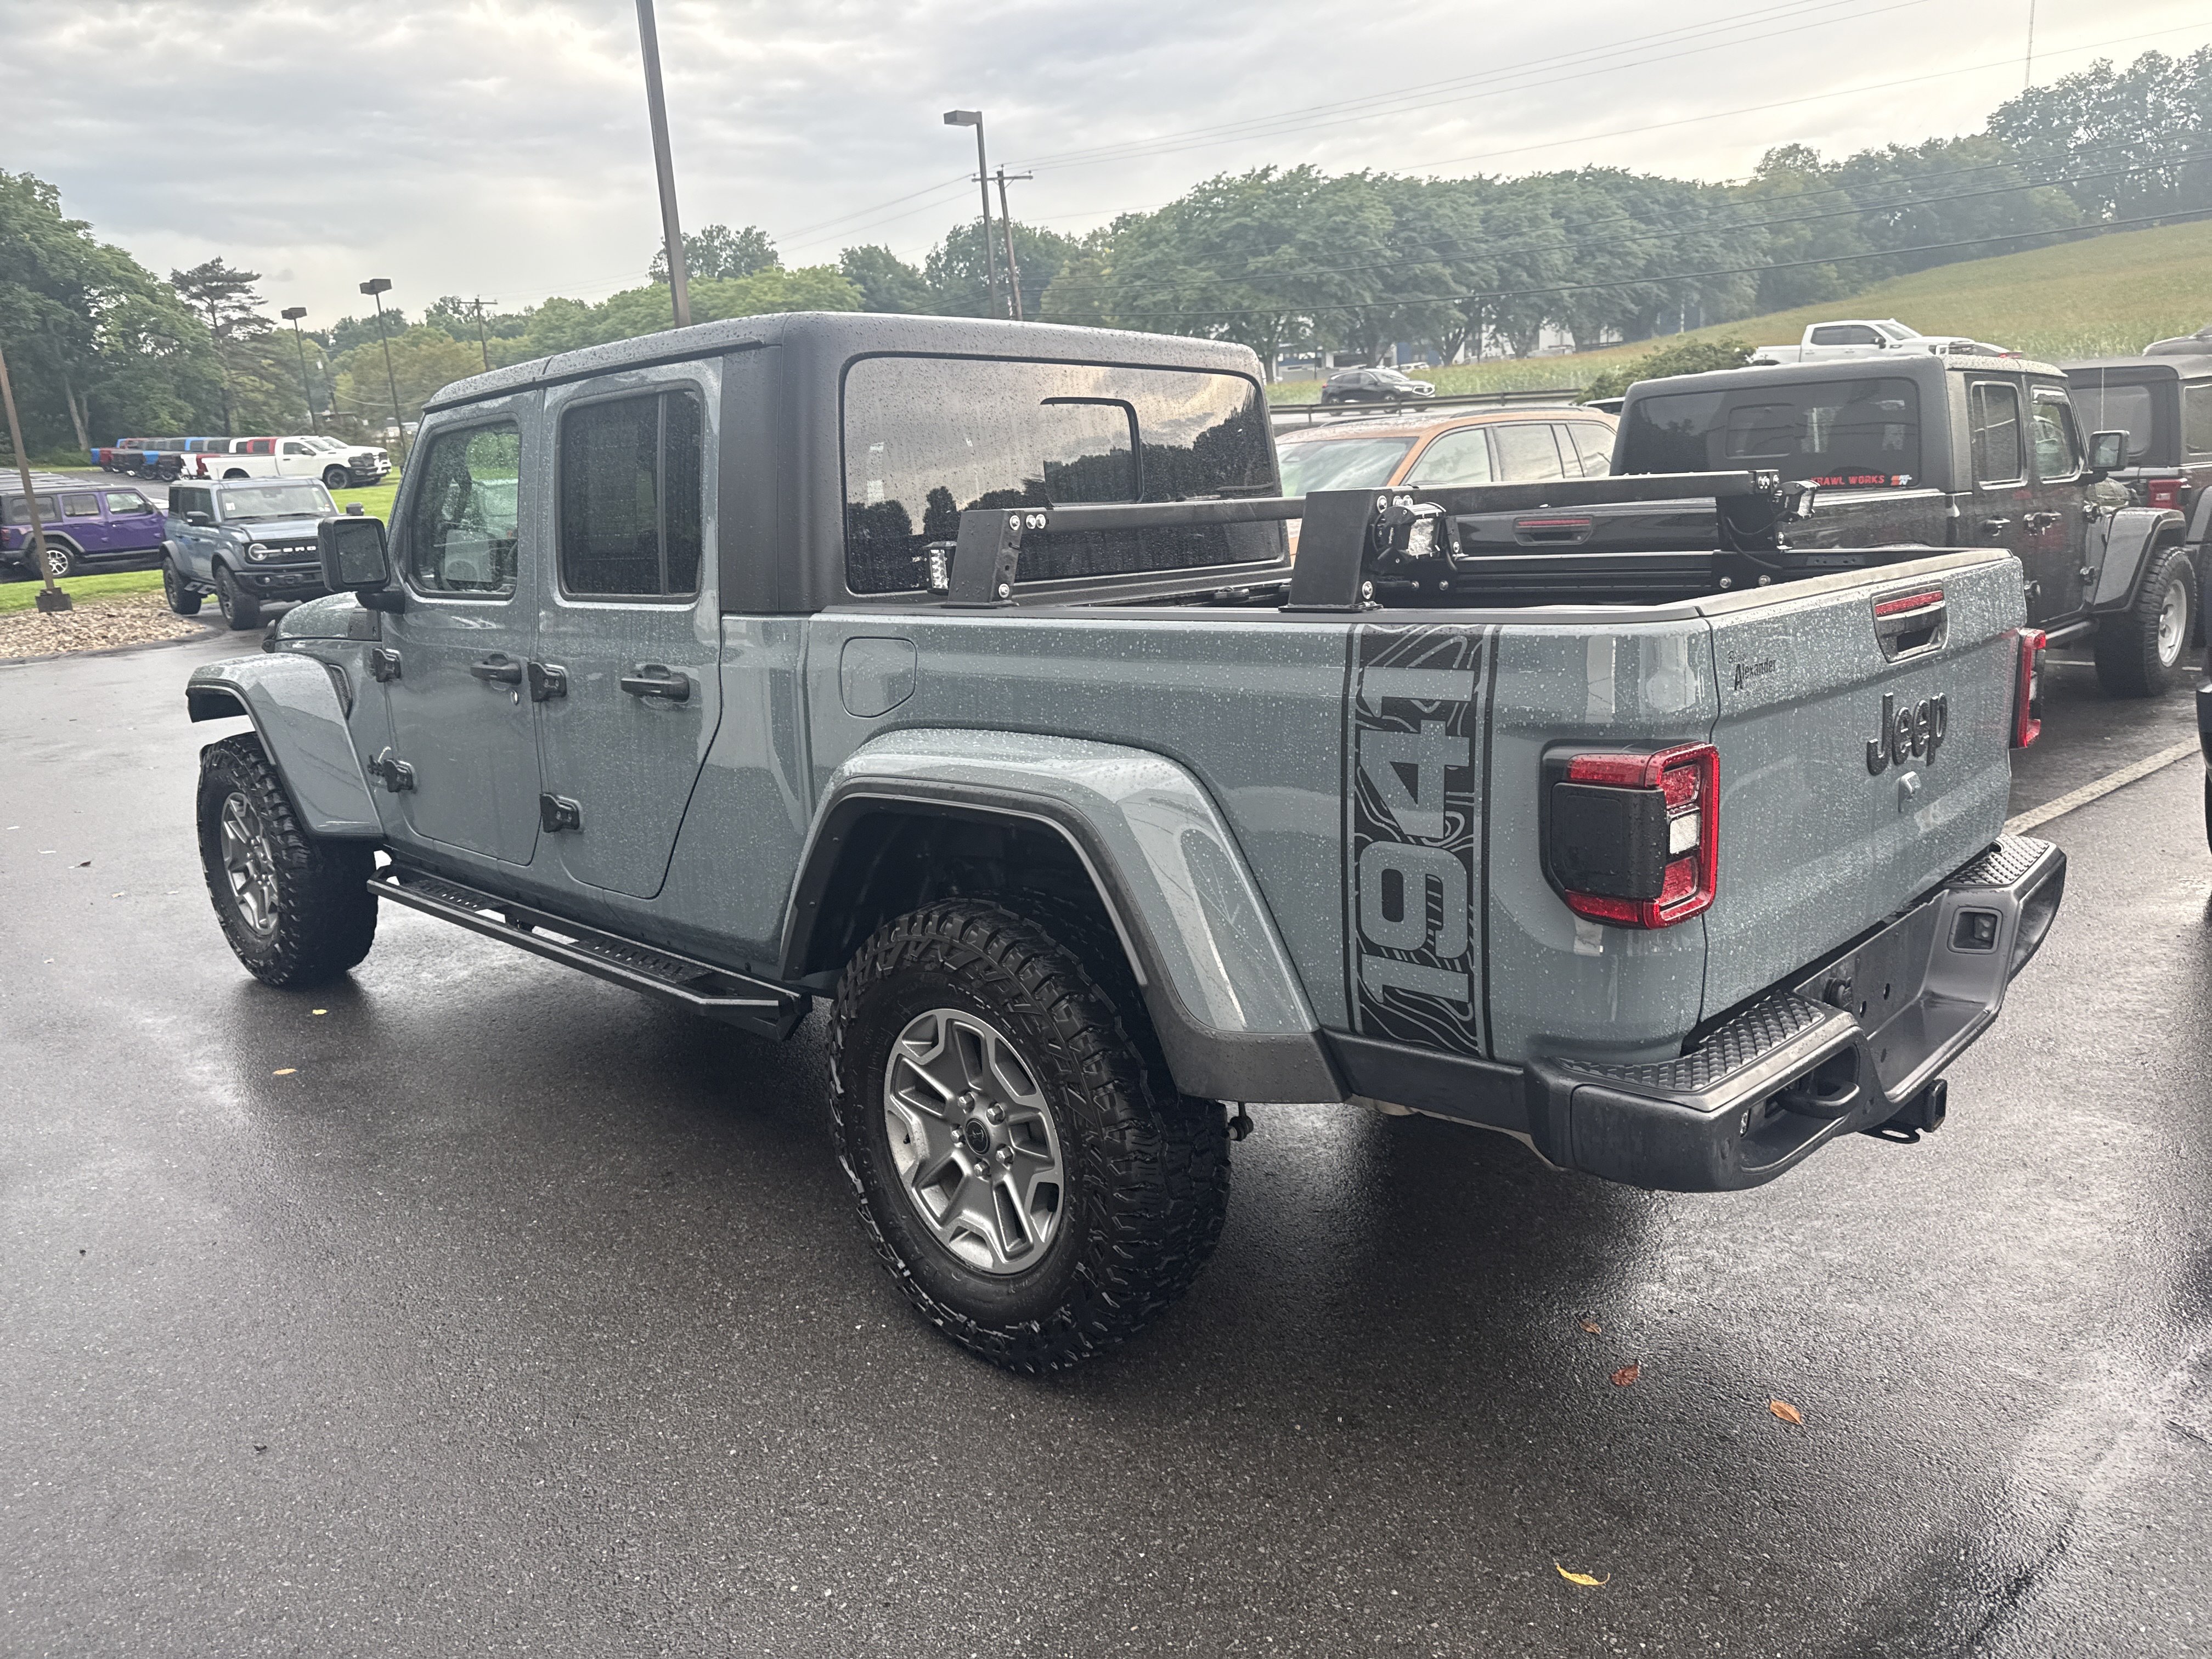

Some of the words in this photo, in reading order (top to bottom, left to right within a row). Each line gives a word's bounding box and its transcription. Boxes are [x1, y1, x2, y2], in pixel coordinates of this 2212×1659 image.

[1849, 475, 1885, 484] WORKS
[1734, 657, 1777, 691] Alexander
[1866, 692, 1947, 776] Jeep
[1360, 665, 1474, 1003] 1941
